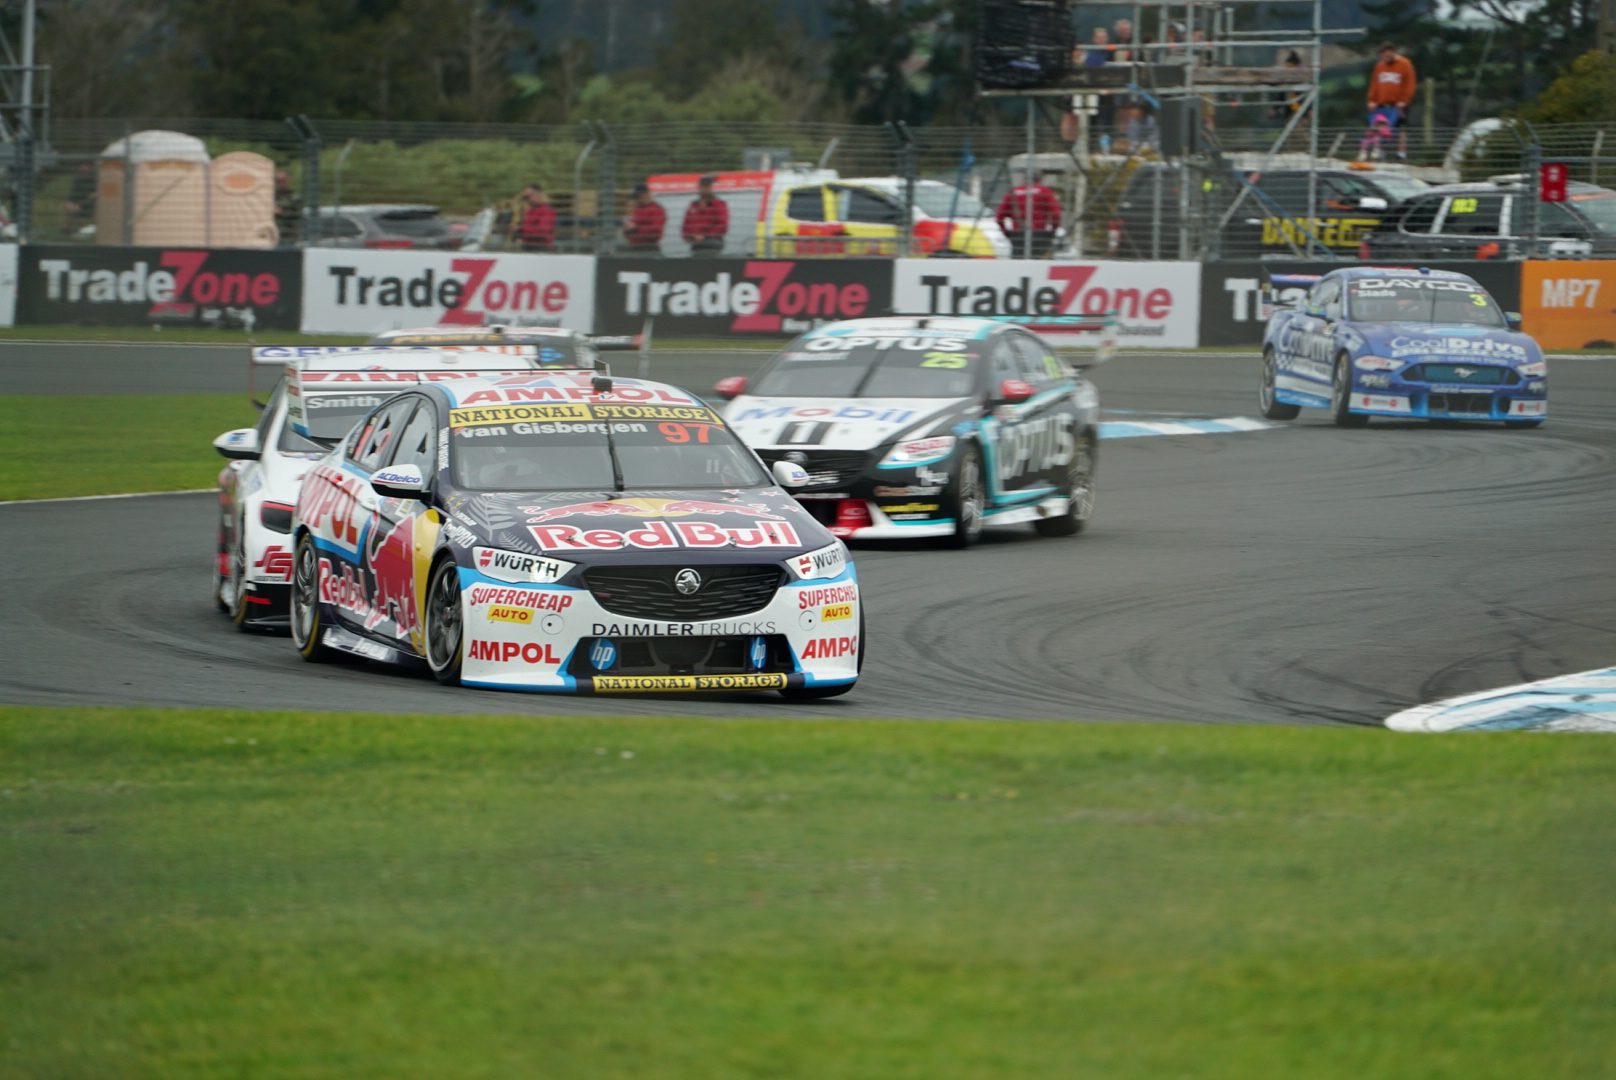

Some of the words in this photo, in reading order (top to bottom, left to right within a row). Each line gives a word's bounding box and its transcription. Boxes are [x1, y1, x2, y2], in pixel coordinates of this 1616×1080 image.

[39, 251, 281, 317] TradeZone
[329, 259, 569, 326] TradeZone
[1358, 279, 1476, 292] DAYCO
[1542, 279, 1601, 308] MP7
[617, 262, 869, 332] TradeZone
[921, 266, 1173, 334] TradeZone
[1470, 294, 1488, 307] 3
[805, 338, 968, 350] OPTUS
[920, 352, 968, 369] 25
[305, 396, 381, 409] Smith
[452, 405, 583, 424] NATIONAL
[594, 406, 710, 421] STORAGE
[735, 406, 913, 424] Mobil
[459, 425, 507, 438] van
[512, 422, 648, 436] Gisbergen
[657, 422, 712, 443] 97
[378, 472, 421, 484] ACDelco
[494, 552, 560, 578] WÜRTH
[812, 548, 843, 570] WÜRT
[470, 587, 573, 613] SUPERCHEAP
[491, 605, 529, 621] AUTO
[824, 606, 851, 618] AUTO
[592, 623, 694, 636] DAIMLER
[699, 621, 776, 636] TRUCKS
[468, 639, 561, 664] AMPOL
[591, 639, 615, 670] hp
[801, 635, 857, 660] AMPO
[598, 676, 691, 690] NATIONAL
[698, 675, 781, 689] STORAGE
